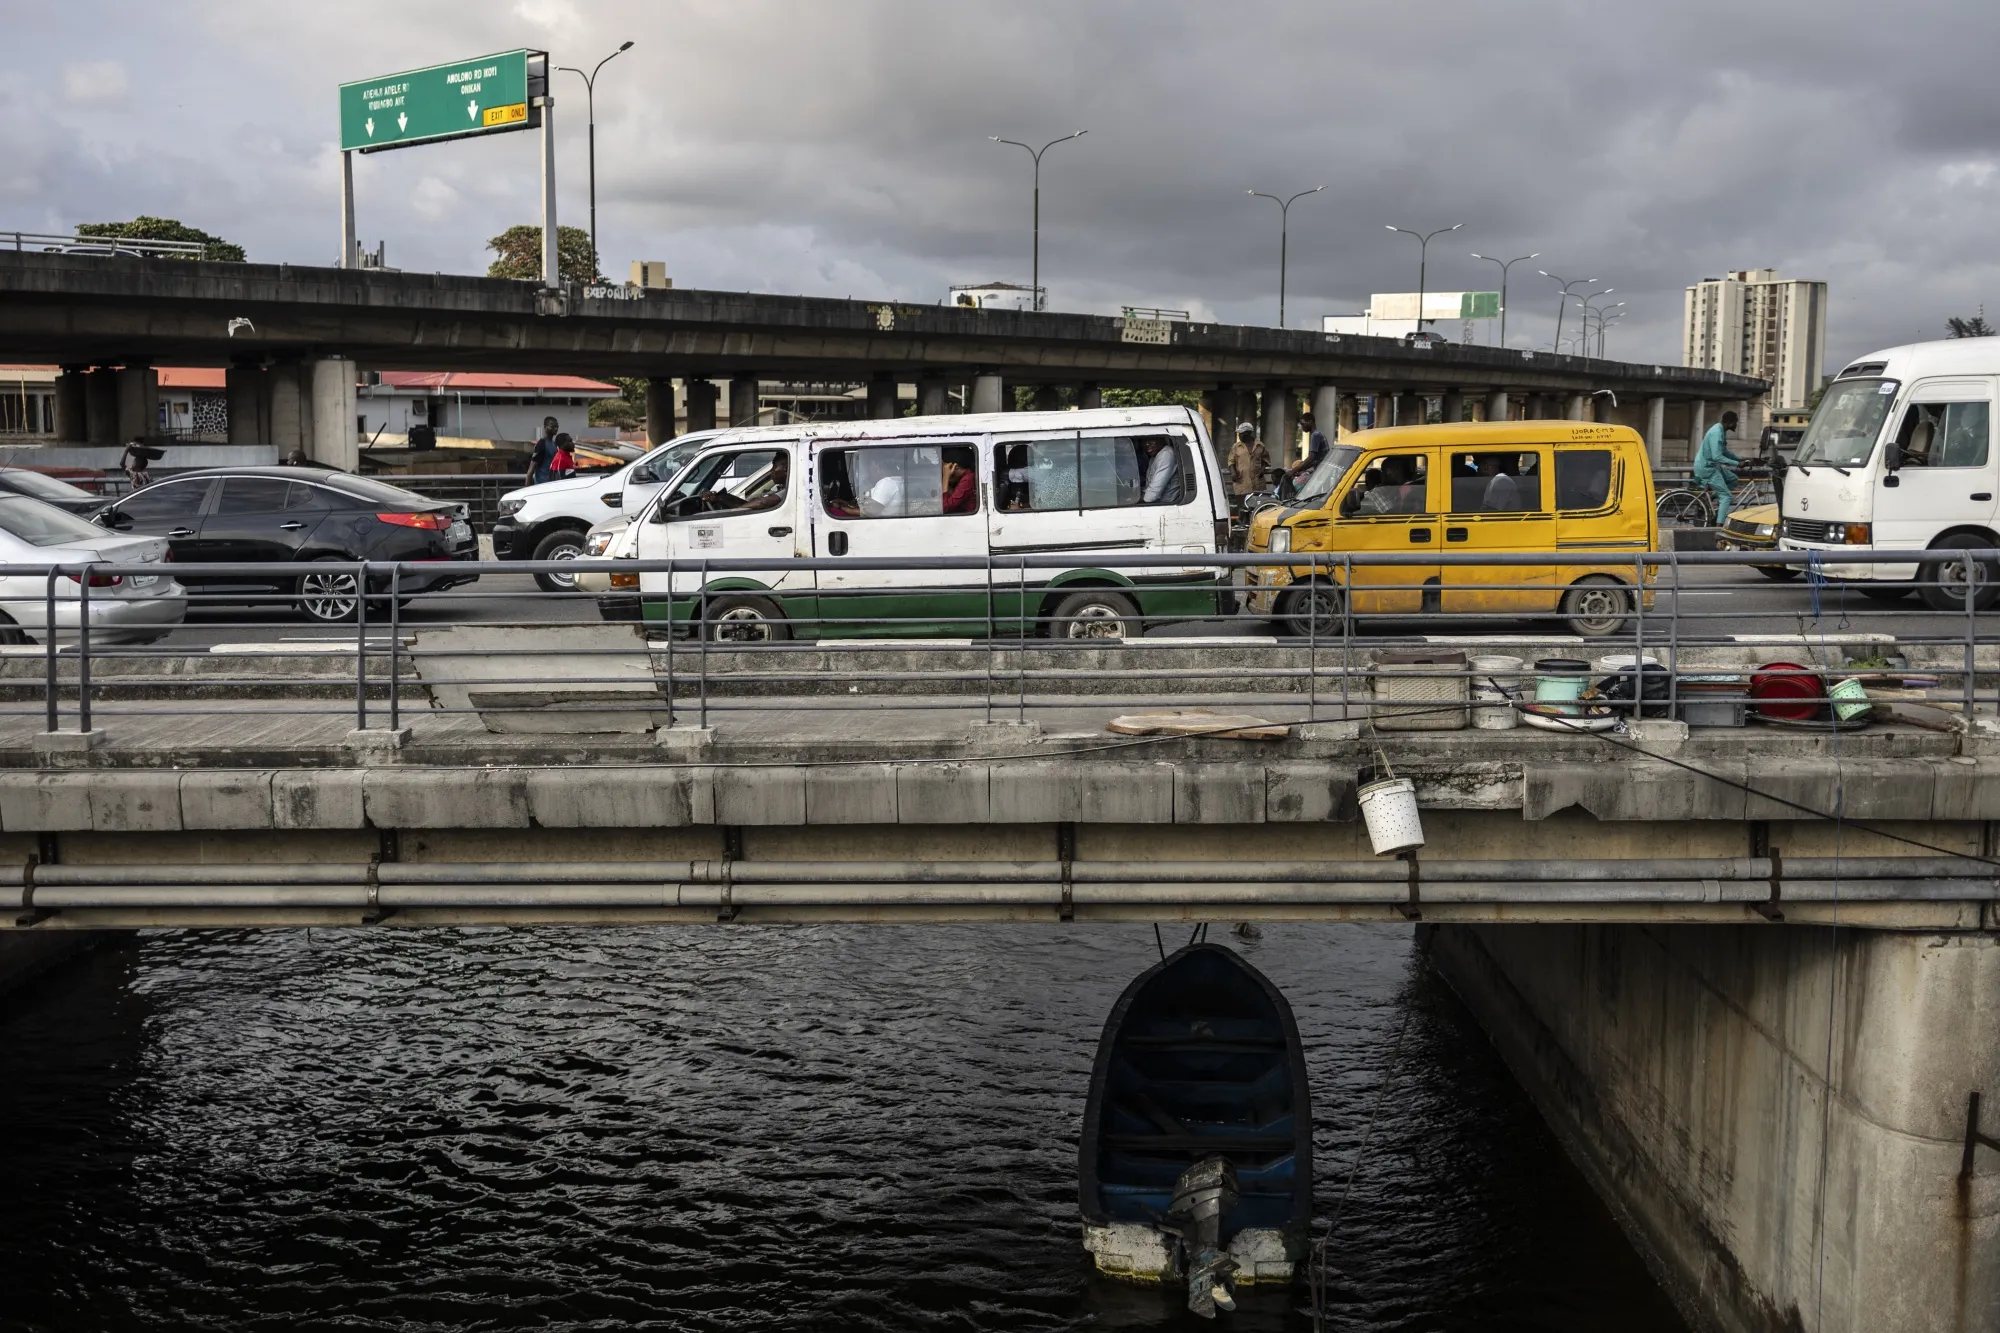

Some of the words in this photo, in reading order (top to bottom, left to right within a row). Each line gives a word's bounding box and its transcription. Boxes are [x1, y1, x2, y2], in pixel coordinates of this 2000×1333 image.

[474, 69, 482, 80] RD
[491, 110, 503, 121] EXIT
[511, 107, 524, 118] ONLY
